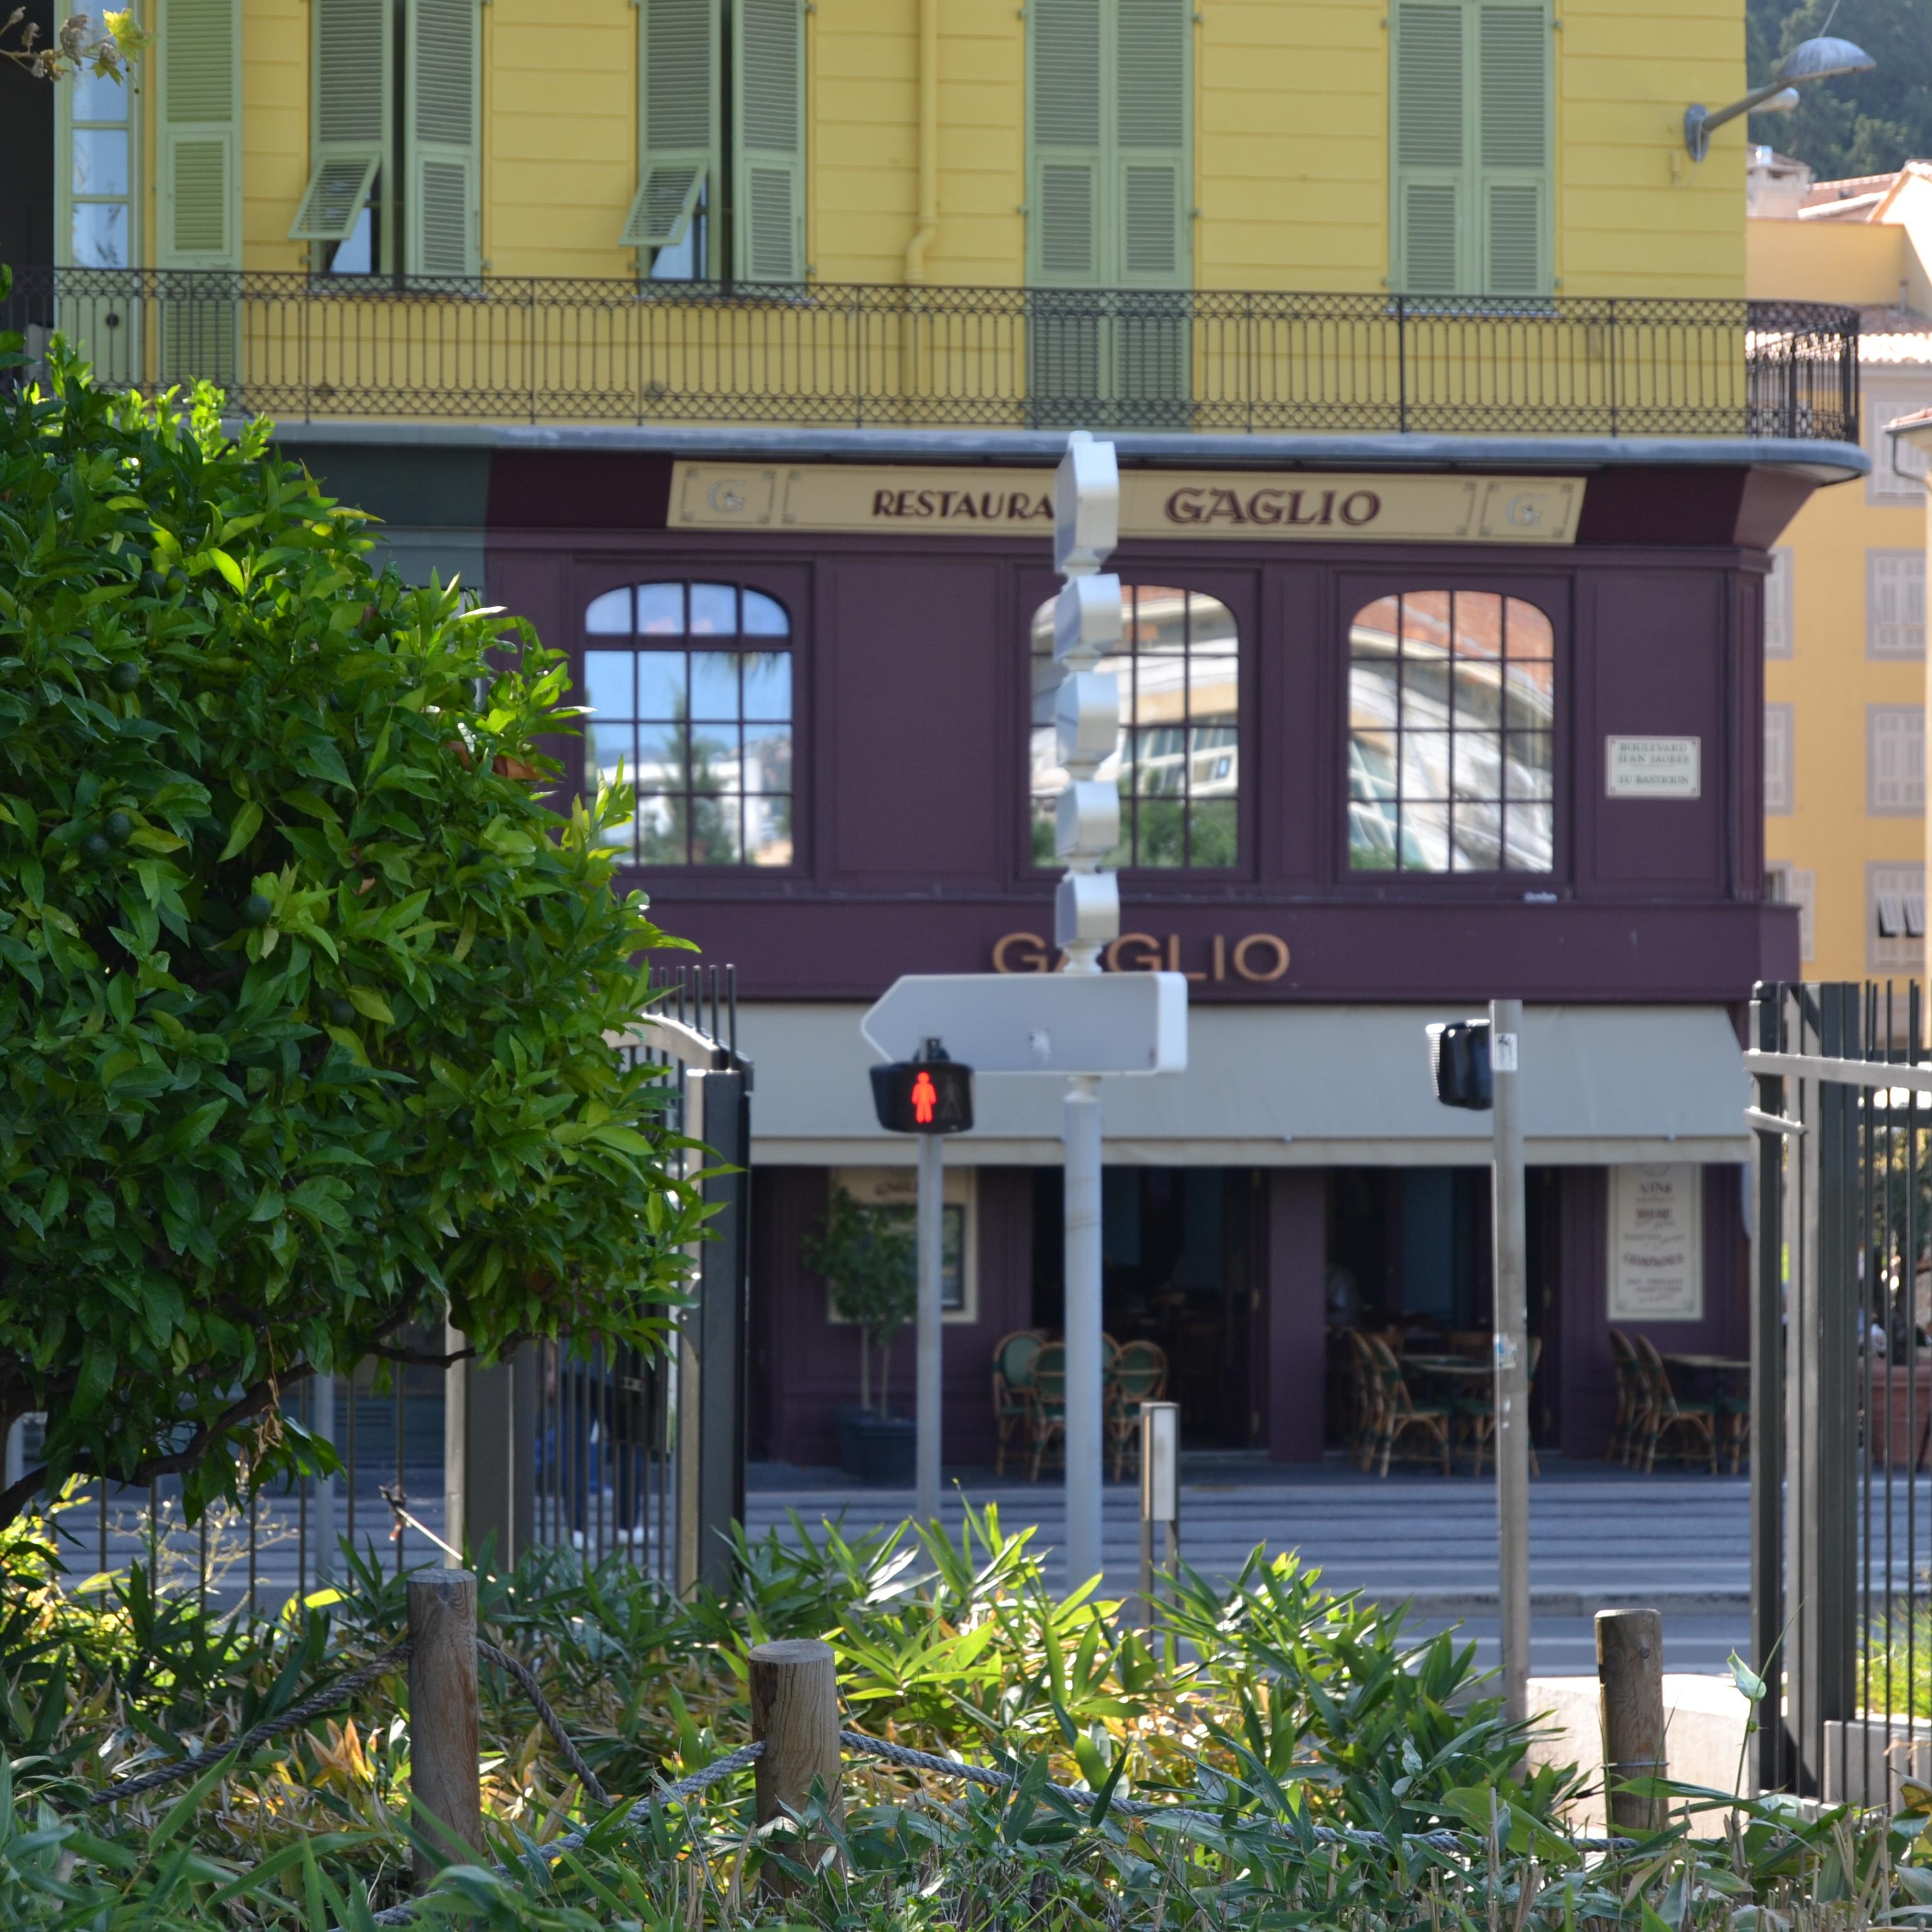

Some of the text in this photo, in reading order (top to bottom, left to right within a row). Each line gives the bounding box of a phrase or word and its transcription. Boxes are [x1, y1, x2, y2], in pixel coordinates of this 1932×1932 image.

[873, 487, 1381, 526] RESTAURA GAGLIO
[1618, 754, 1645, 763] JEAN
[1620, 743, 1687, 752] BOULEVARD
[992, 932, 1291, 982] GGLIO
